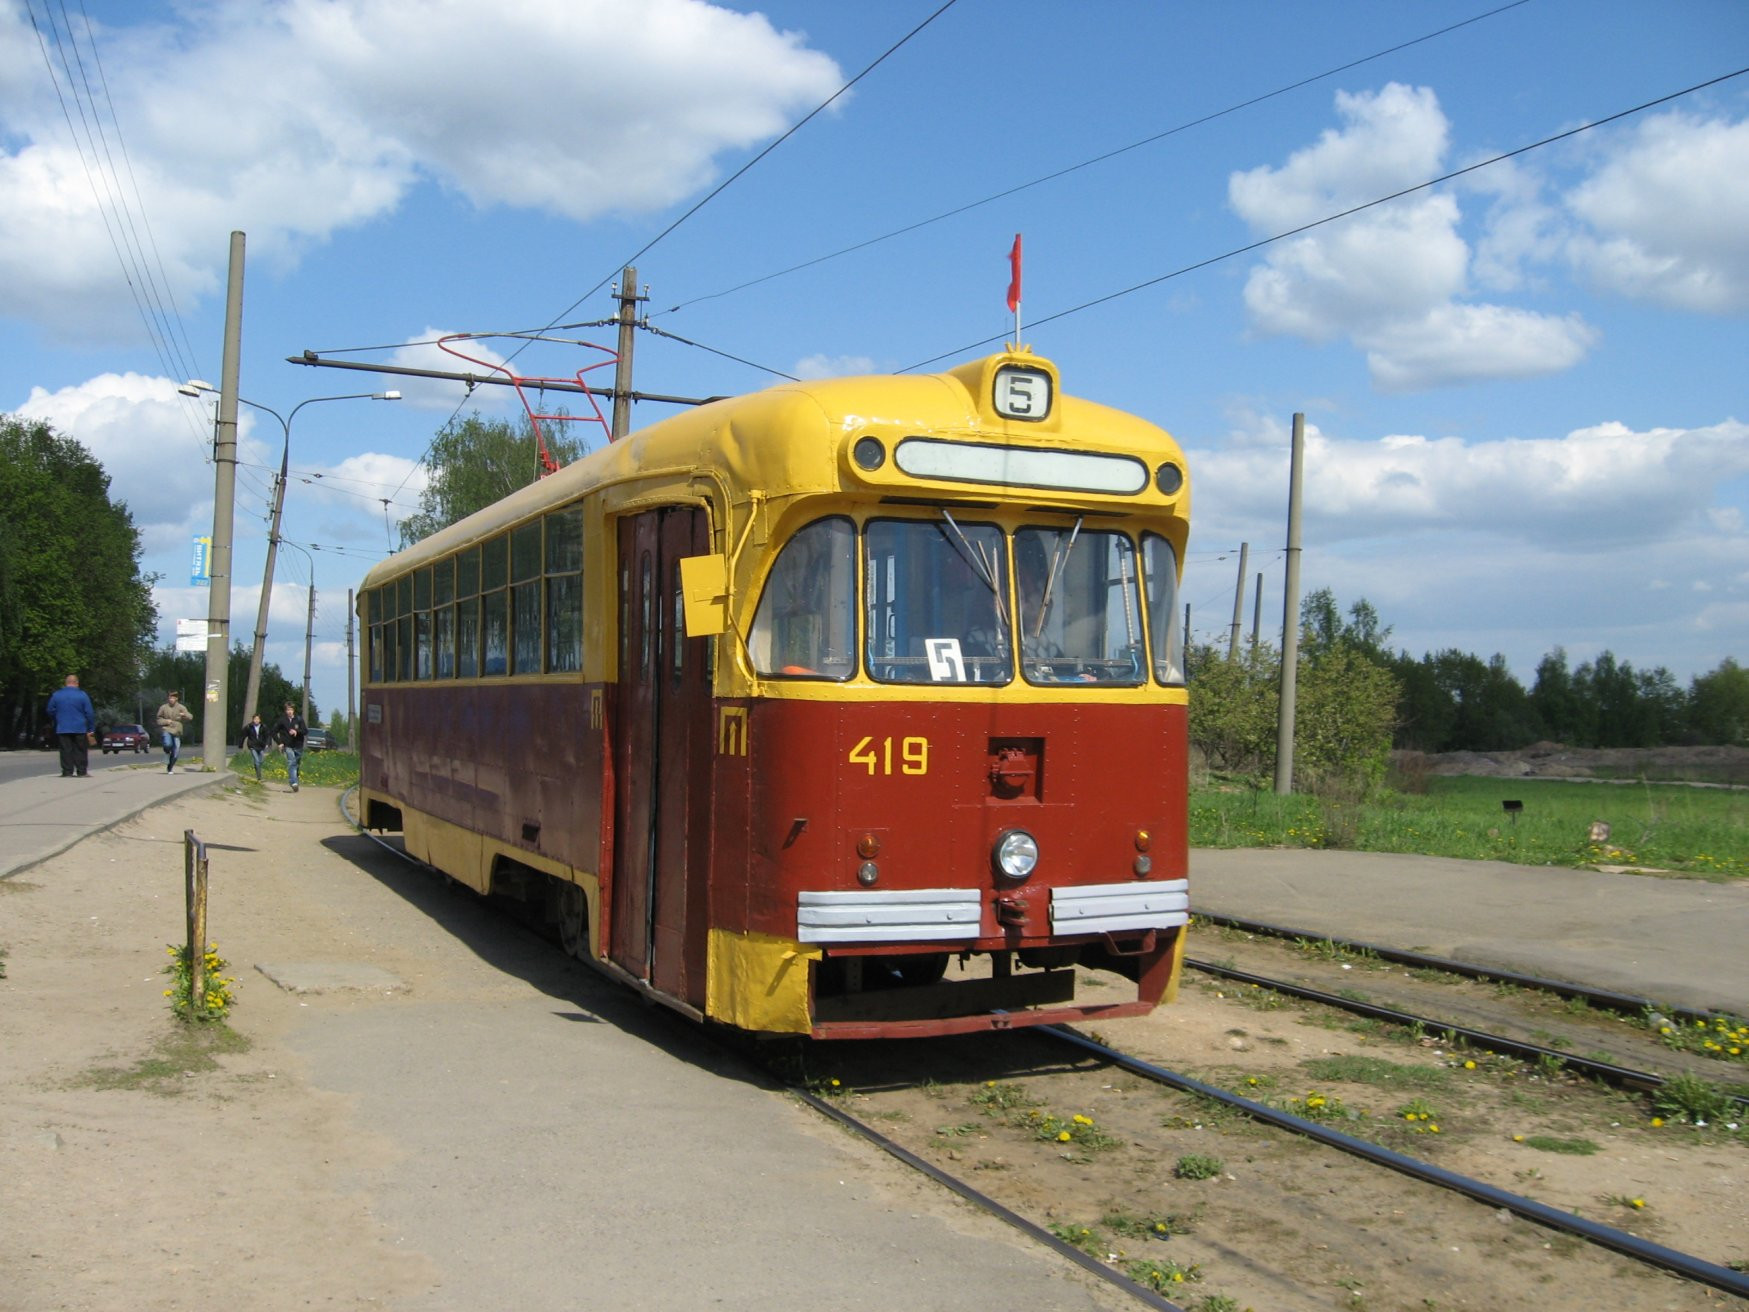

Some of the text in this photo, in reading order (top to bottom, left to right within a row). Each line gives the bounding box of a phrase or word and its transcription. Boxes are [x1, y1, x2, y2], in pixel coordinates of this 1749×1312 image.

[1009, 376, 1034, 415] 5
[933, 642, 959, 681] 5
[849, 736, 928, 775] 419
